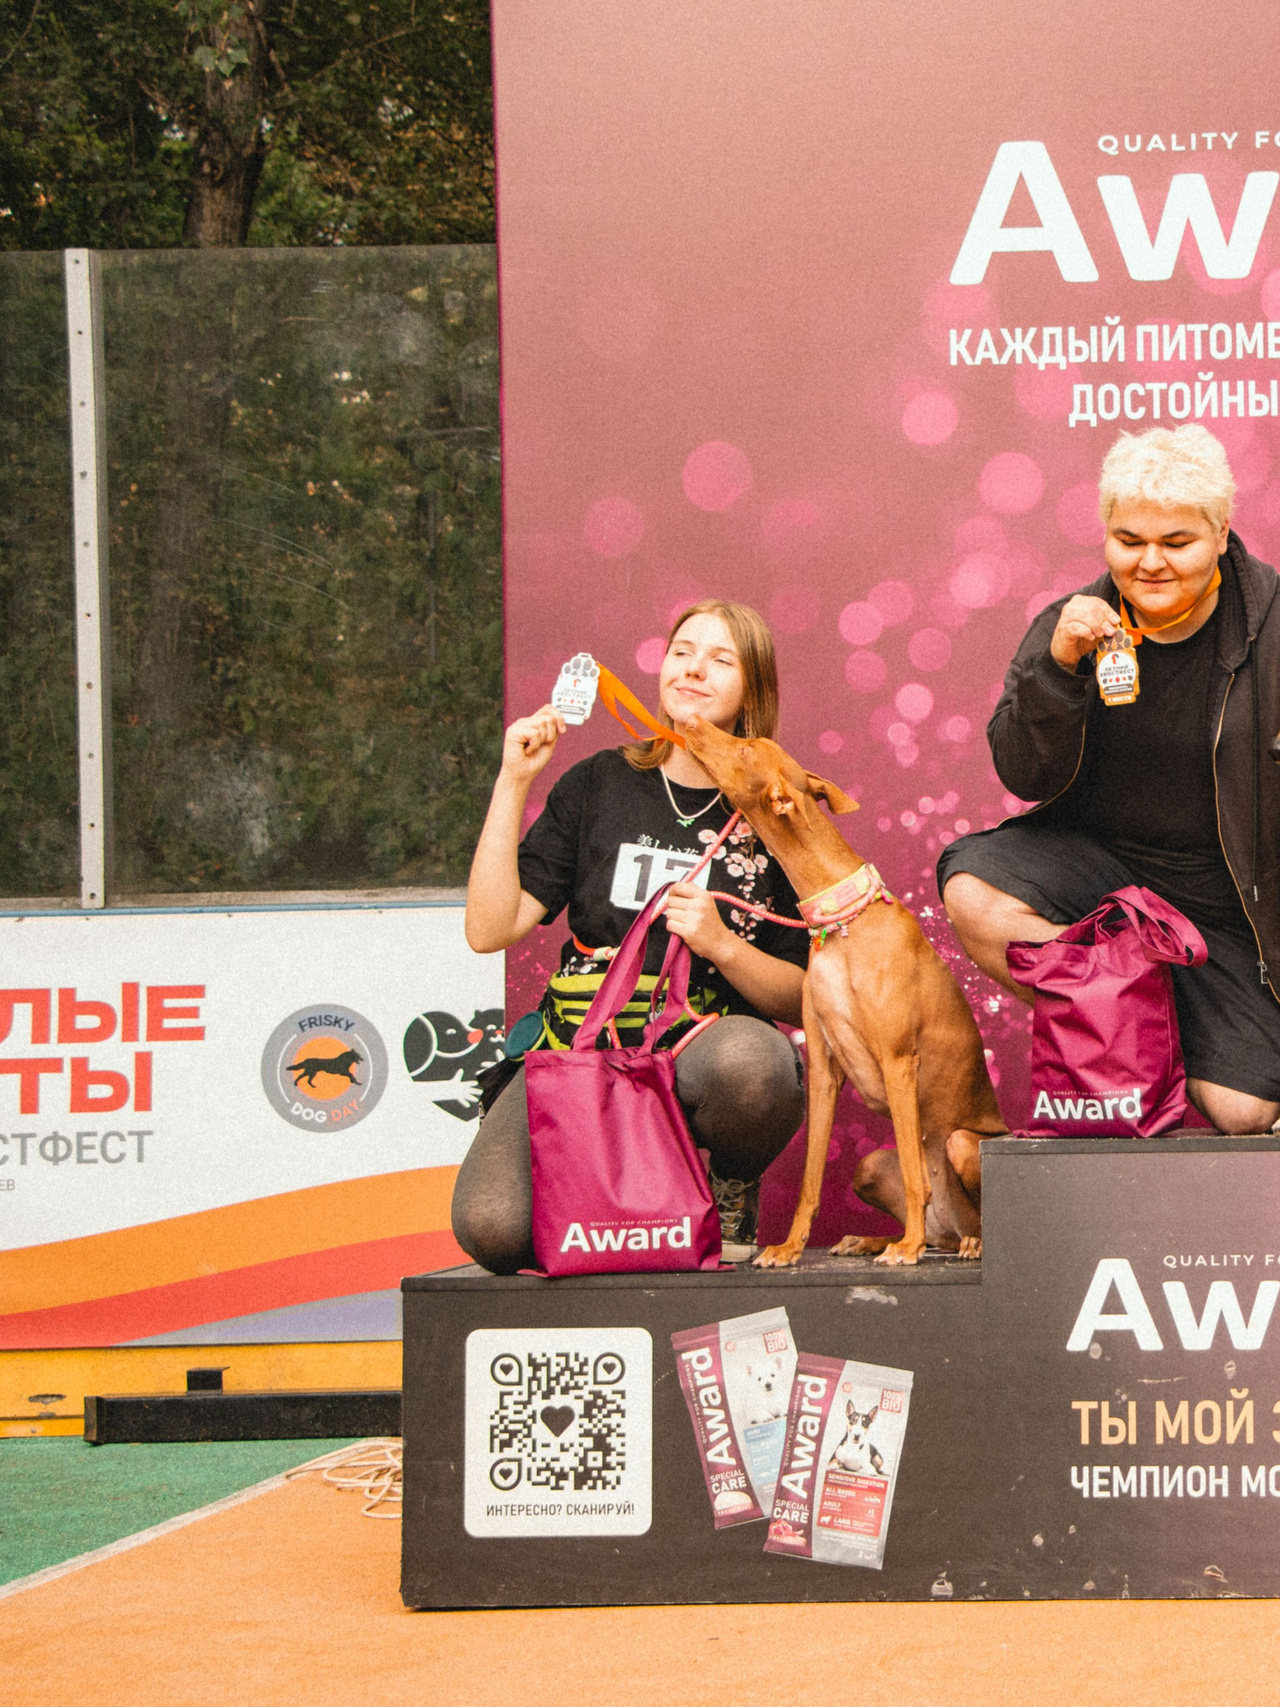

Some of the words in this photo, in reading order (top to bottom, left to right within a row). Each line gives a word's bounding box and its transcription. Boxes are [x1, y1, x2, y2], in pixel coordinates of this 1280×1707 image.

[1097, 131, 1240, 156] QUALITY
[949, 316, 1126, 370] КАЖДЫЙ
[298, 1014, 355, 1032] FRISKY
[290, 1102, 327, 1123] DOG
[331, 1099, 359, 1121] DAY
[1033, 1088, 1142, 1120] Award
[560, 1216, 692, 1252] Award
[1163, 1254, 1255, 1269] QUALITY
[768, 1339, 787, 1351] BIO
[681, 1347, 736, 1466] Award
[882, 1401, 900, 1411] BIO
[1071, 1400, 1137, 1445] ТЫ
[1155, 1388, 1254, 1444] МОЙ
[781, 1374, 828, 1499] Award
[710, 1469, 744, 1483] SPECIAL
[711, 1476, 747, 1494] CARE
[1070, 1465, 1229, 1498] ЧЕМПИОН
[486, 1503, 562, 1516] ИНТЕРЕСНО?
[566, 1500, 635, 1516] СКАНИРУЙ!
[773, 1507, 809, 1524] CARE
[775, 1499, 809, 1512] SPECIAL
